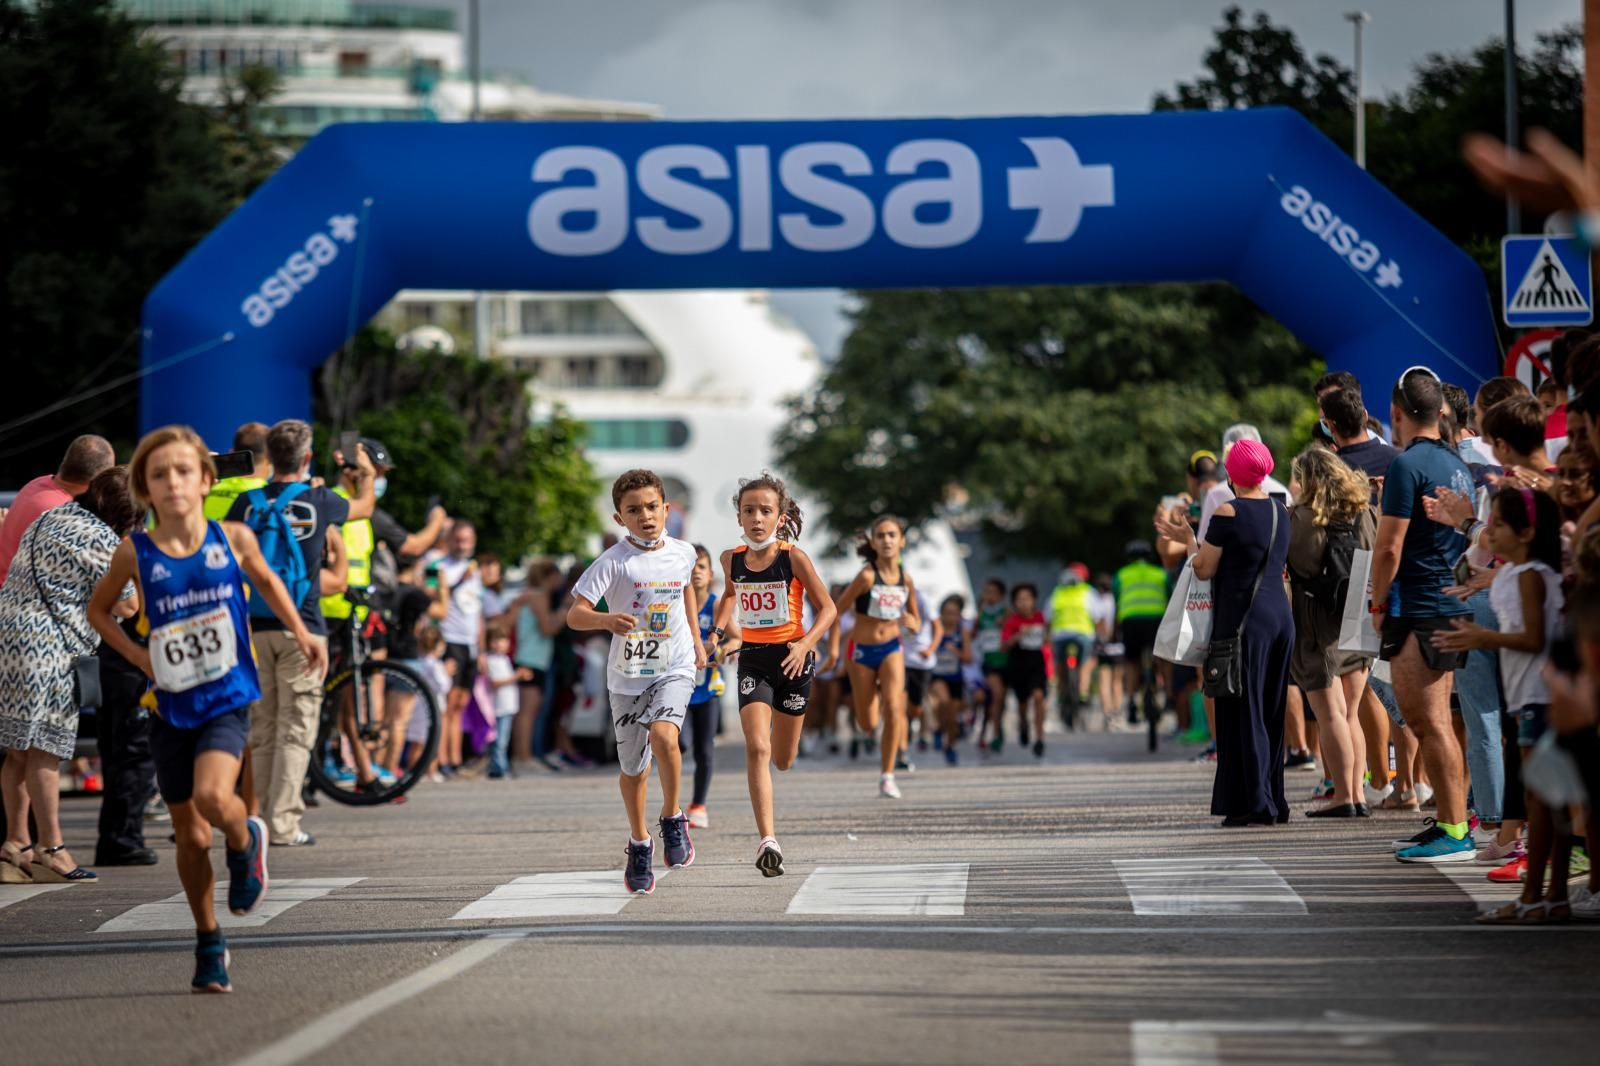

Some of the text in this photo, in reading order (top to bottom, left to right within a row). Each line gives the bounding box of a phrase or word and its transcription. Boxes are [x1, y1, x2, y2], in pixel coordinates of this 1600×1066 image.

[527, 139, 983, 257] asisa
[1279, 183, 1382, 273] asisa
[241, 231, 340, 328] asisa
[739, 591, 777, 612] 603
[165, 628, 221, 667] 633
[624, 640, 660, 661] 642
